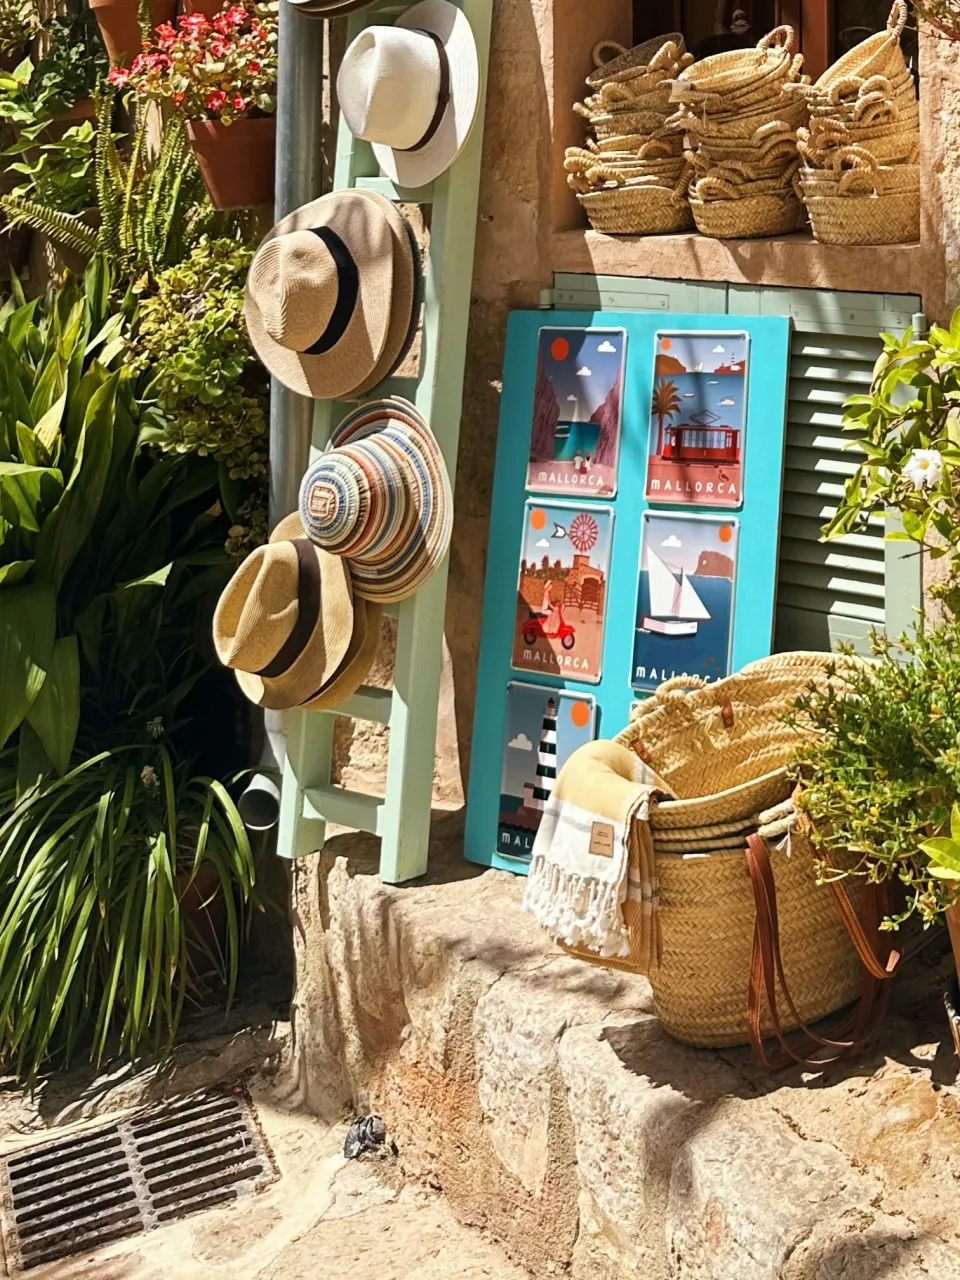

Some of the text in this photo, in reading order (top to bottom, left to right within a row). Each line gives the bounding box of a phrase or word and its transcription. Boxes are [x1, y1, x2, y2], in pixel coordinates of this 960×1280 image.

[538, 471, 604, 486] MALLORCA
[651, 479, 736, 494] MALLORCA
[523, 649, 589, 670] MALLORCA
